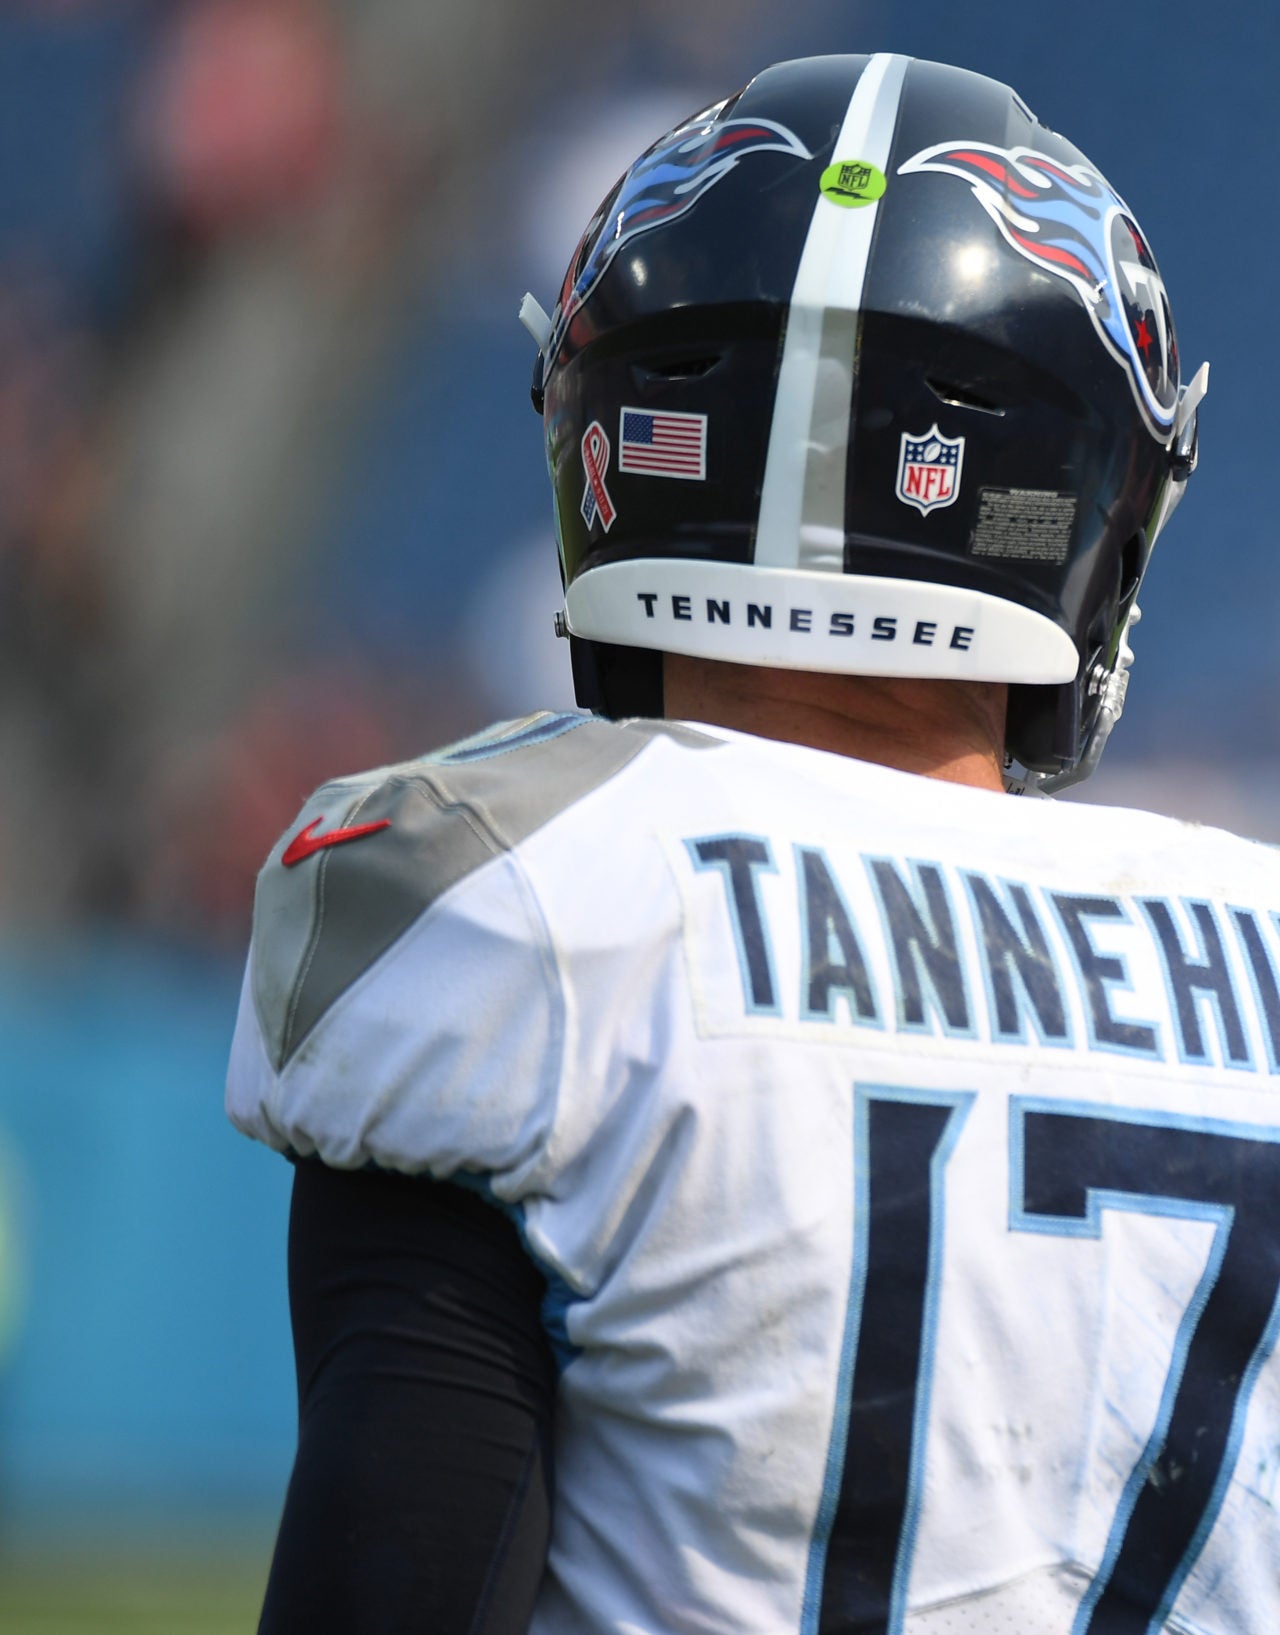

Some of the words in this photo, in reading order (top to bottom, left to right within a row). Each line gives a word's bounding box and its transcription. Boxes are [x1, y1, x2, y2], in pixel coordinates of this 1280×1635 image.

[840, 173, 868, 189] NFL
[906, 465, 951, 500] NFL
[637, 593, 975, 651] TENNESSEE
